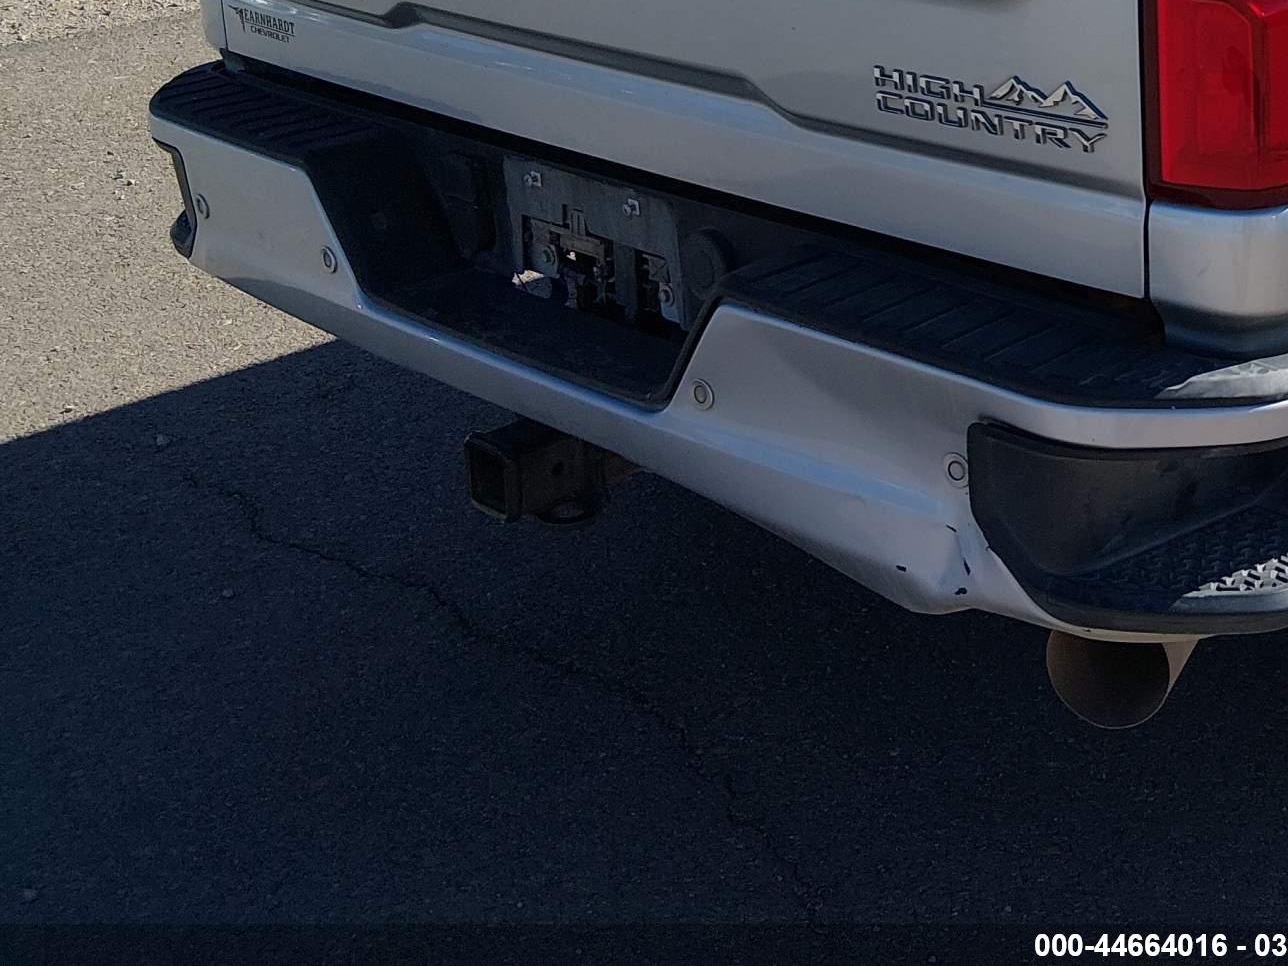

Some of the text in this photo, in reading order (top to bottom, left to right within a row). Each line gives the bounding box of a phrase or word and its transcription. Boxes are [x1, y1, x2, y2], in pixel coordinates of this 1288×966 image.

[244, 8, 295, 35] EARNHARDT
[250, 25, 290, 43] CHEVROLET
[873, 65, 985, 107] HIGH
[876, 90, 1108, 153] COUNTRY
